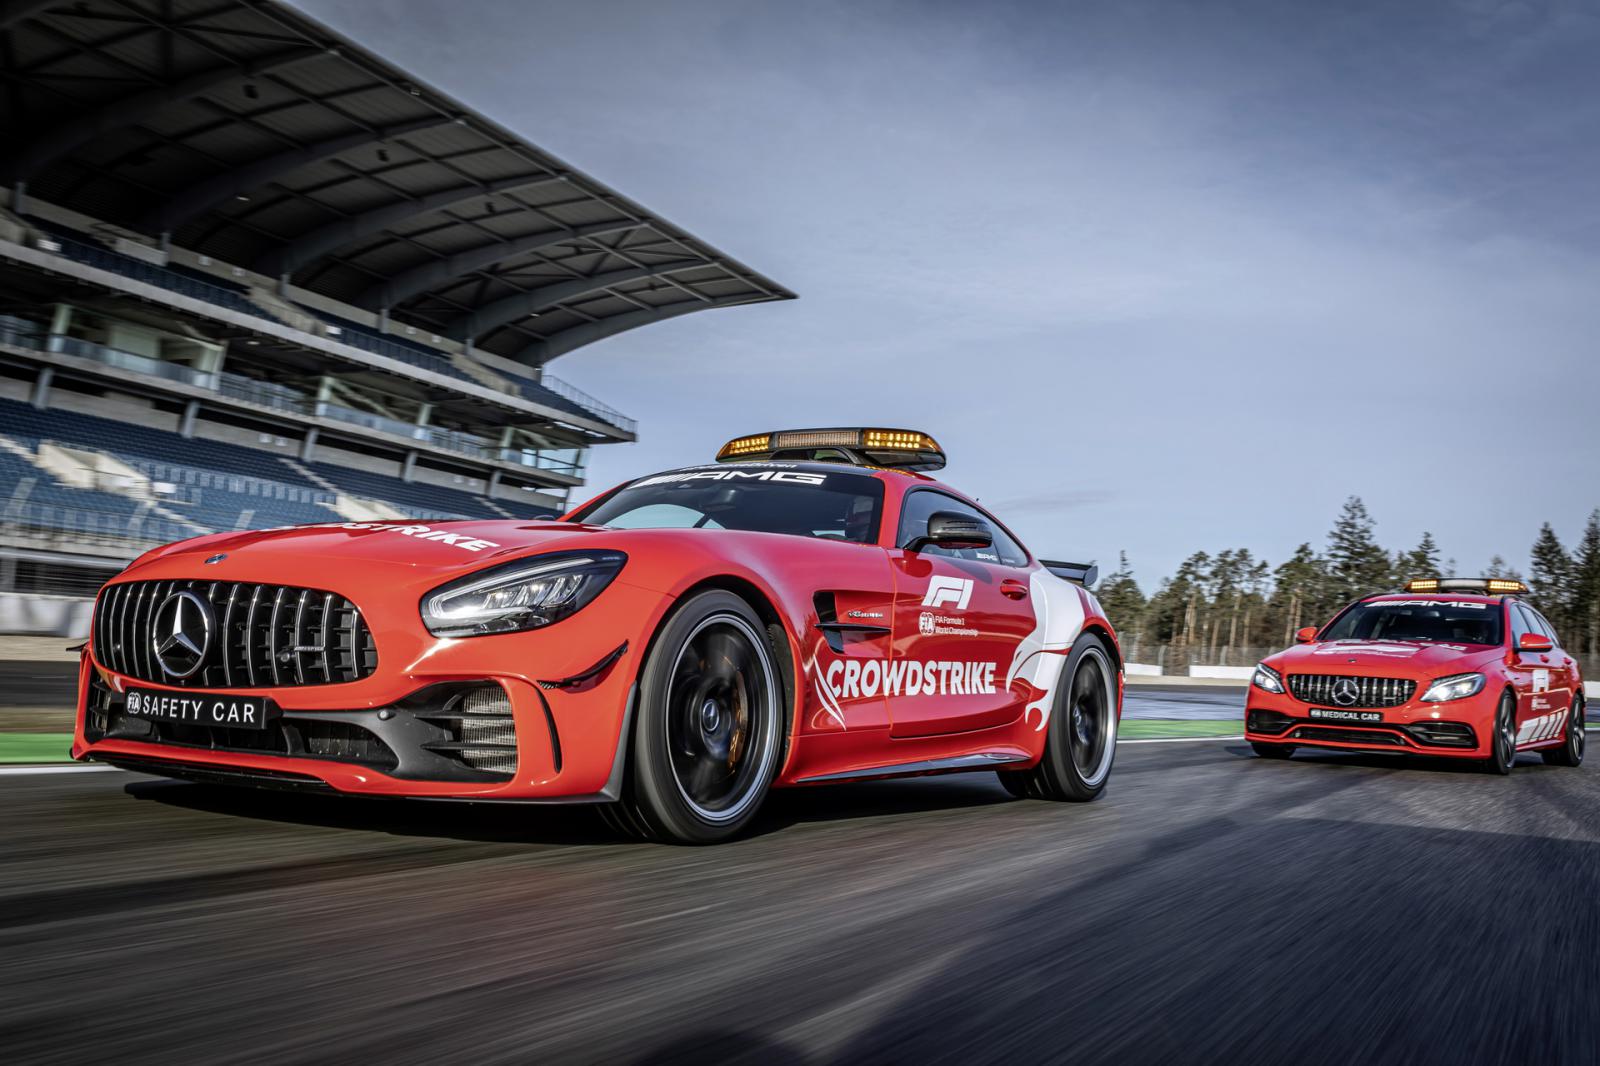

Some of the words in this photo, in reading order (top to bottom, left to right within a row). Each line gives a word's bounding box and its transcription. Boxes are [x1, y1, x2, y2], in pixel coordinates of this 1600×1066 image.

[681, 471, 827, 485] AMG
[921, 575, 974, 610] F1
[1402, 601, 1487, 609] AMG
[827, 659, 996, 697] CROWDSTRIKE
[127, 694, 141, 712] FIA
[143, 695, 203, 720] SAFETY
[213, 702, 255, 723] CAR
[1321, 710, 1359, 720] MEDICAL
